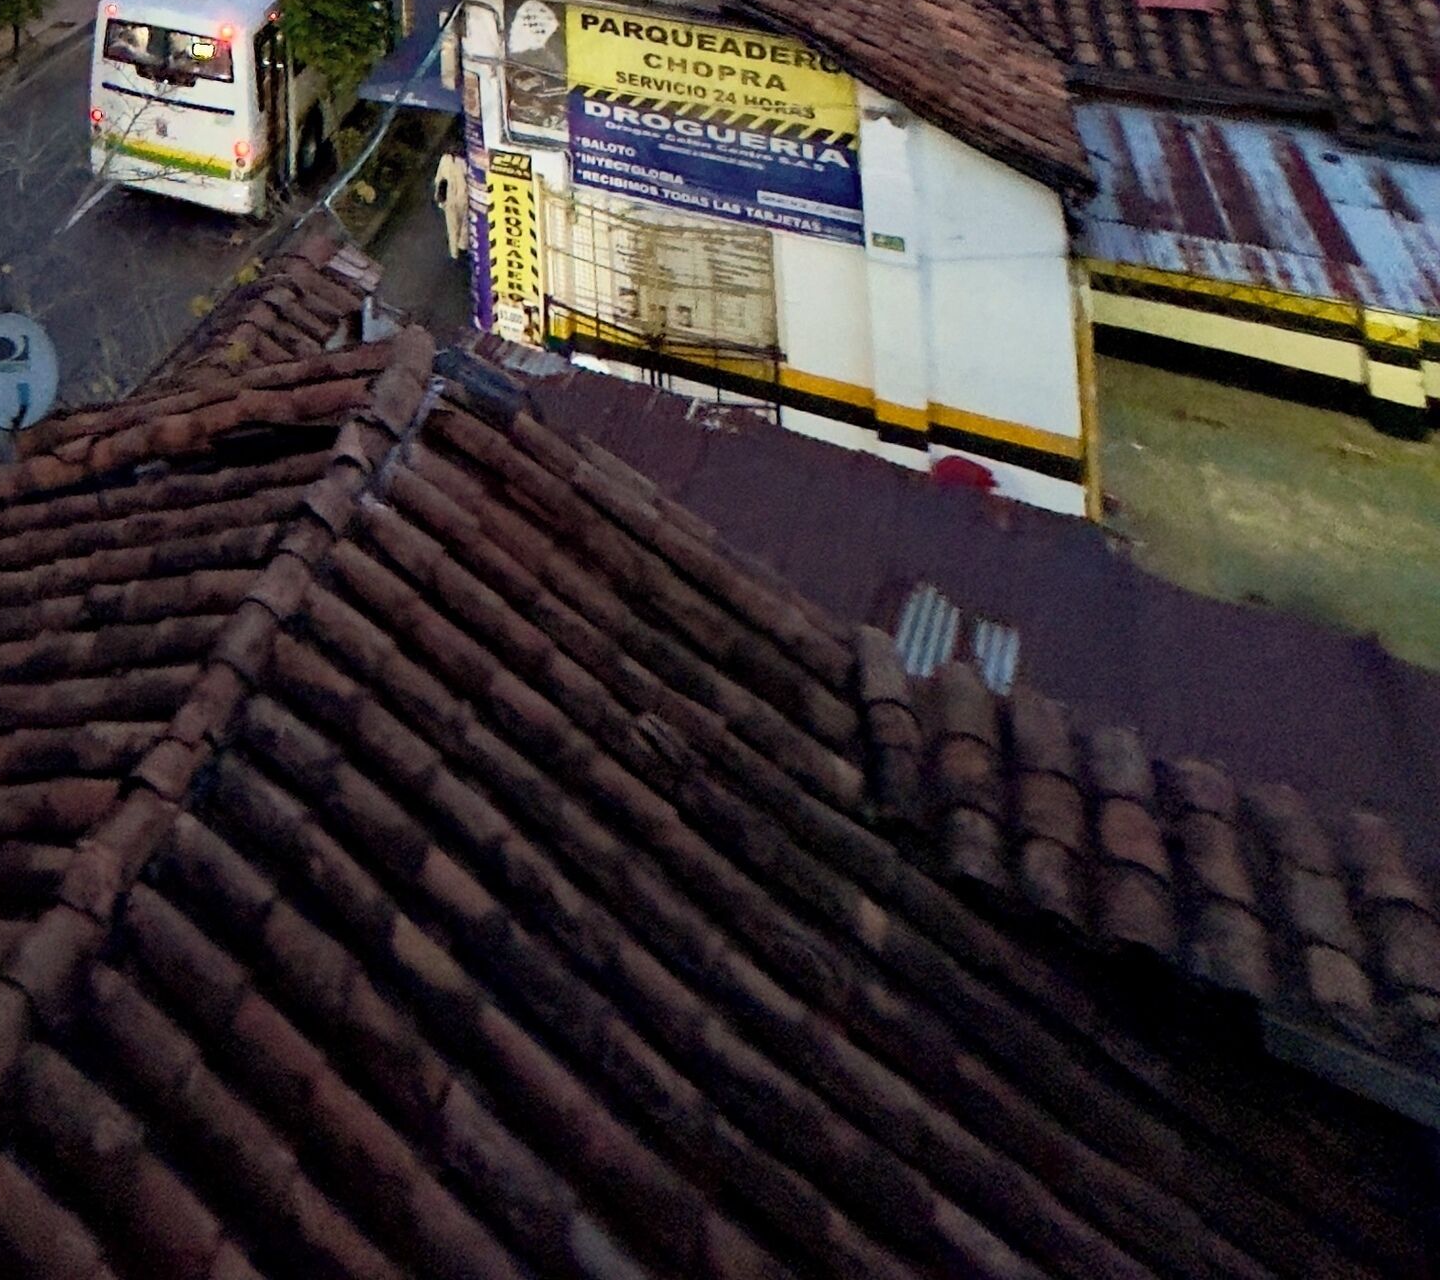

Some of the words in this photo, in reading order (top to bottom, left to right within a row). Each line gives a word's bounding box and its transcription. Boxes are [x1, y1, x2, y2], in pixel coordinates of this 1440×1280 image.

[581, 13, 842, 74] PARQUEADERO
[615, 71, 707, 99] SERVICIO
[713, 89, 737, 104] 24
[744, 94, 815, 119] HORAS
[643, 52, 786, 92] CHOPRA
[584, 100, 850, 168] DROGUERIA
[662, 188, 709, 208] TODAS
[712, 199, 741, 215] LAS
[745, 206, 822, 232] TARJETAS
[502, 183, 526, 302] PARQUEADERO
